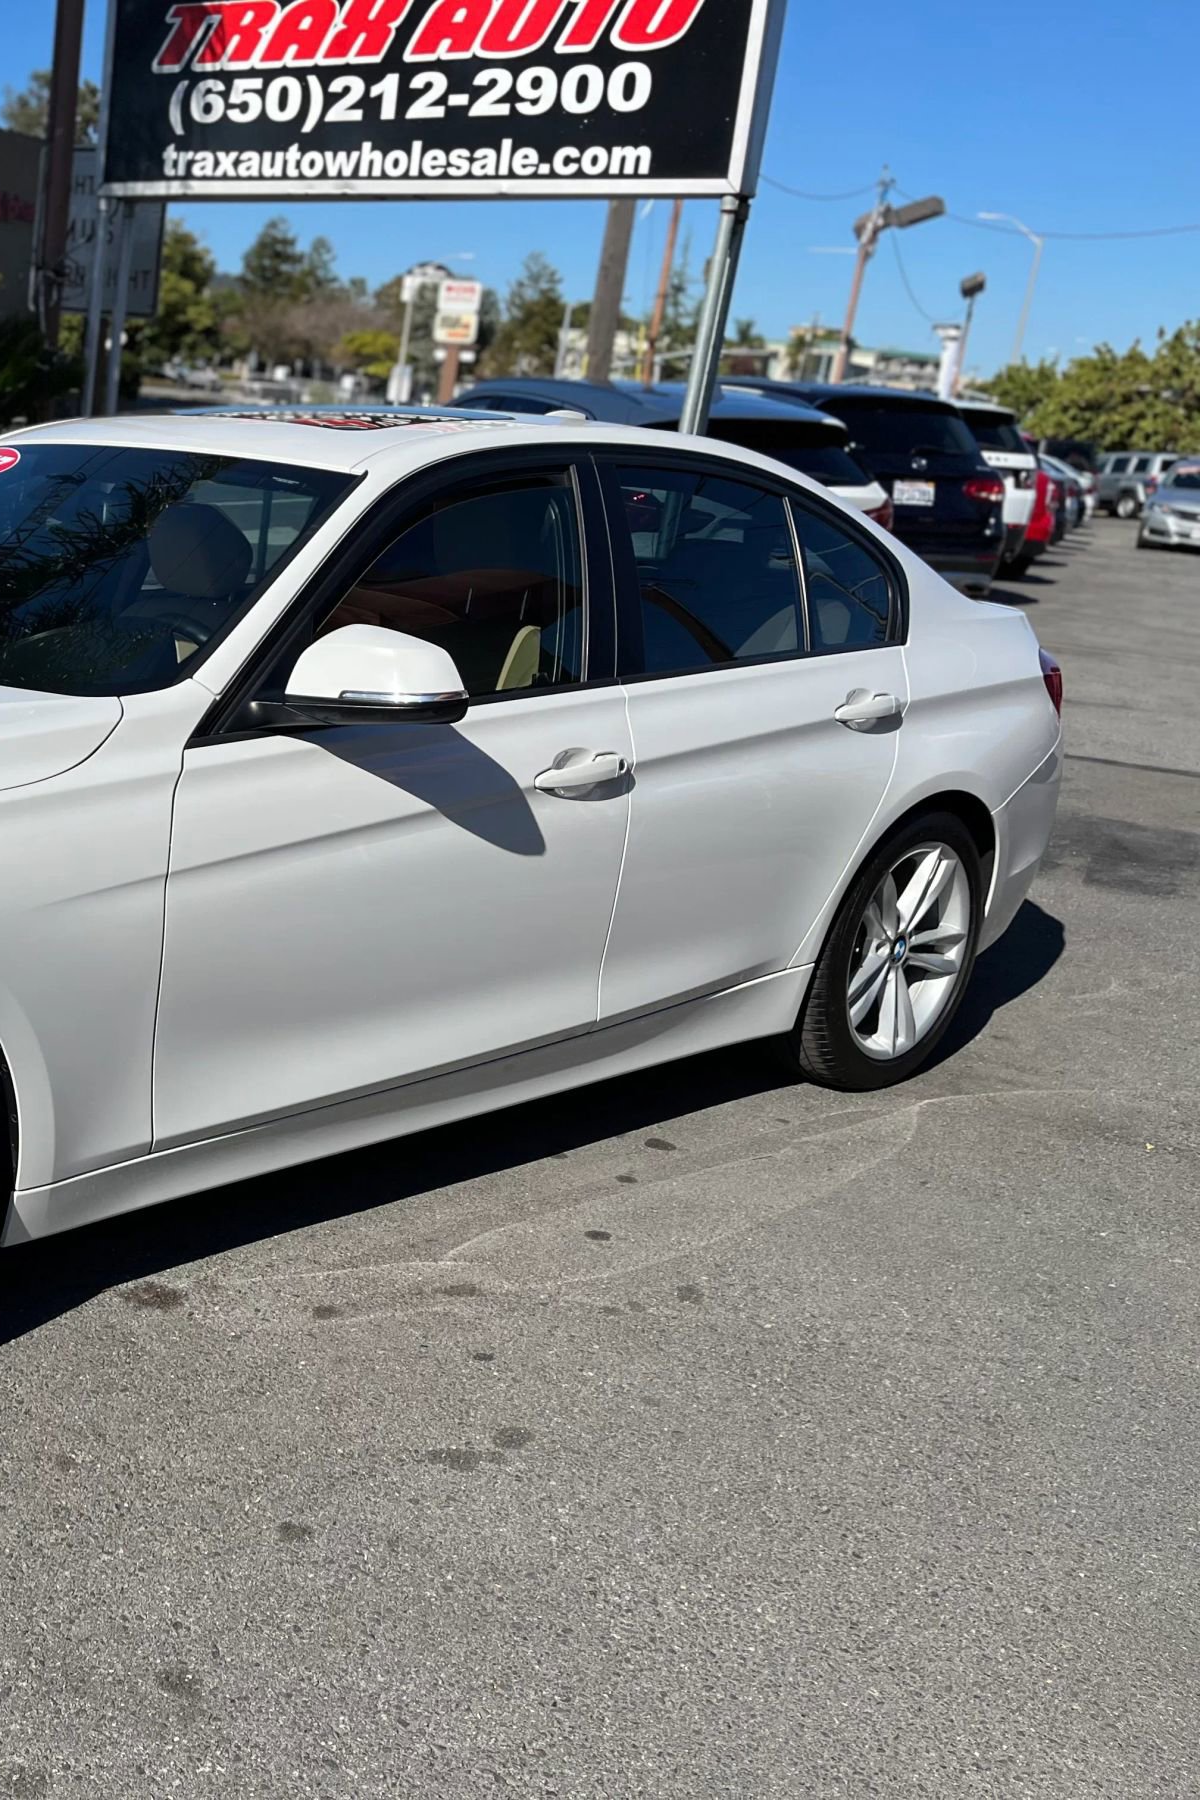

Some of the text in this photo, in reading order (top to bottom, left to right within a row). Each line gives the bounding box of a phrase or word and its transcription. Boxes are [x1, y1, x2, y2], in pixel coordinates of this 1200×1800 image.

[152, 0, 413, 74] TRAX
[168, 62, 652, 135] (650)212-2900
[162, 138, 652, 177] traxautowholesale.com
